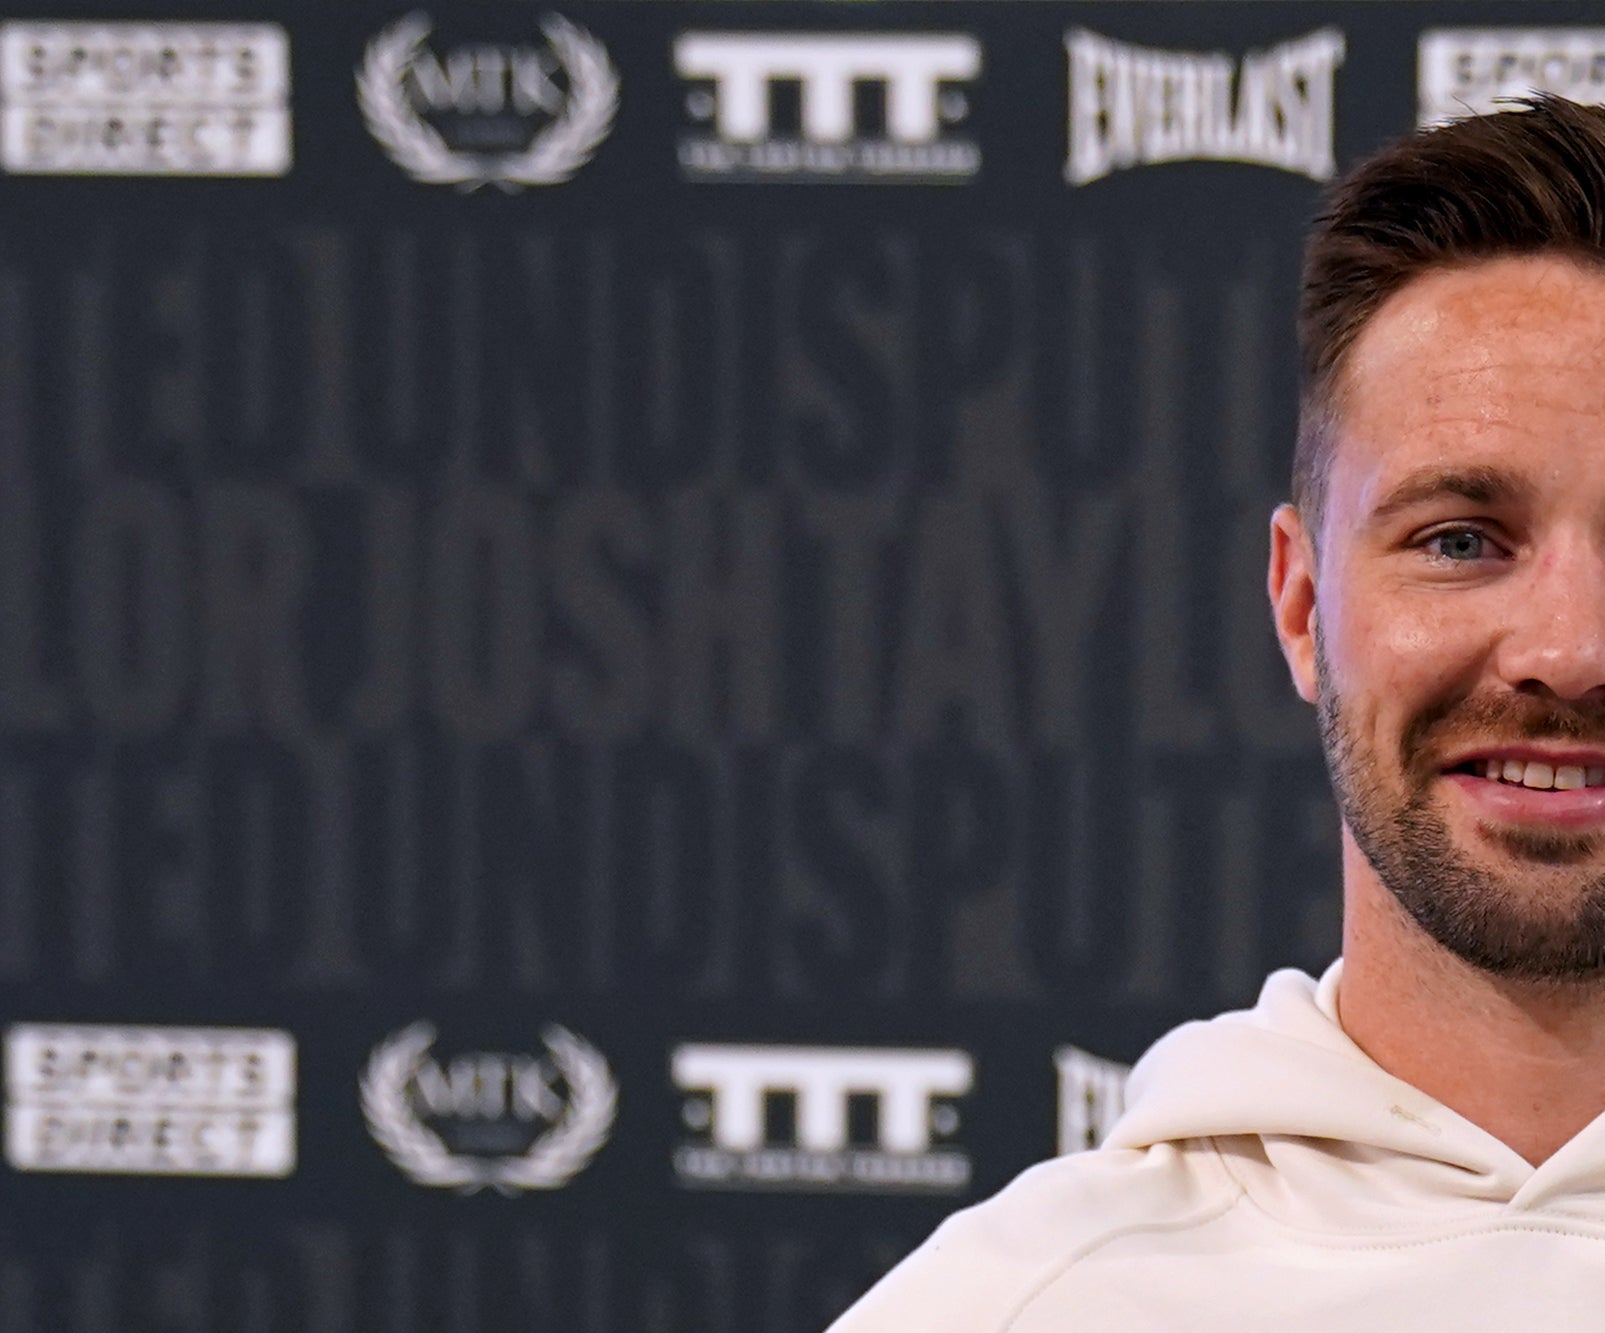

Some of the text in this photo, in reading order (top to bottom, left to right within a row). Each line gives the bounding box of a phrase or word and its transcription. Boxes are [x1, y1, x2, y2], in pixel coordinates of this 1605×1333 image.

[27, 44, 263, 94] SPORTS
[403, 45, 568, 118] MTK
[1064, 26, 1347, 187] EVERLAST
[25, 111, 259, 163] DIRECT
[36, 1046, 270, 1096] SPORTS
[406, 1056, 570, 1126] MTK
[36, 1113, 262, 1165] DIRECT
